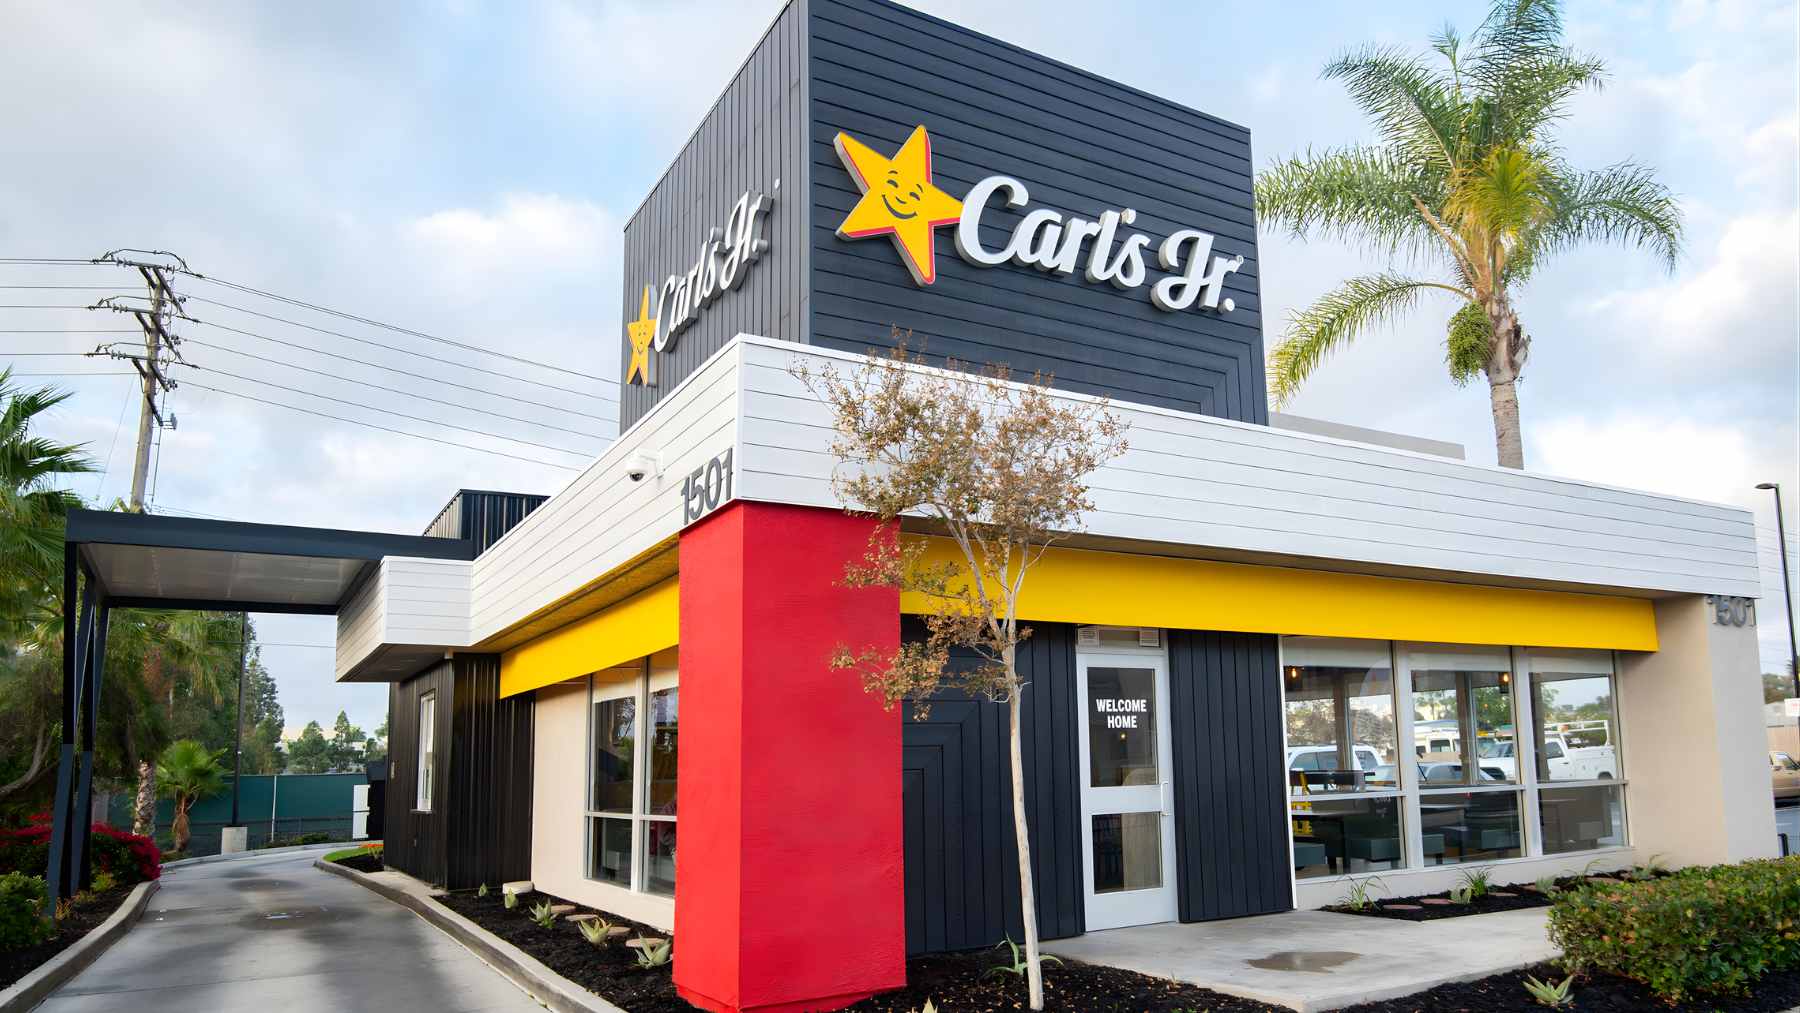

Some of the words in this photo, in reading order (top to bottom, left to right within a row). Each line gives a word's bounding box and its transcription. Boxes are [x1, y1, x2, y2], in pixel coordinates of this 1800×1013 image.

[956, 175, 1151, 291] Carl's
[1150, 229, 1238, 312] Jr.
[654, 227, 723, 353] Carl's
[681, 447, 733, 526] 1501
[1707, 595, 1757, 628] 1501
[1096, 699, 1147, 713] WELCOME
[1107, 715, 1138, 729] HOME
